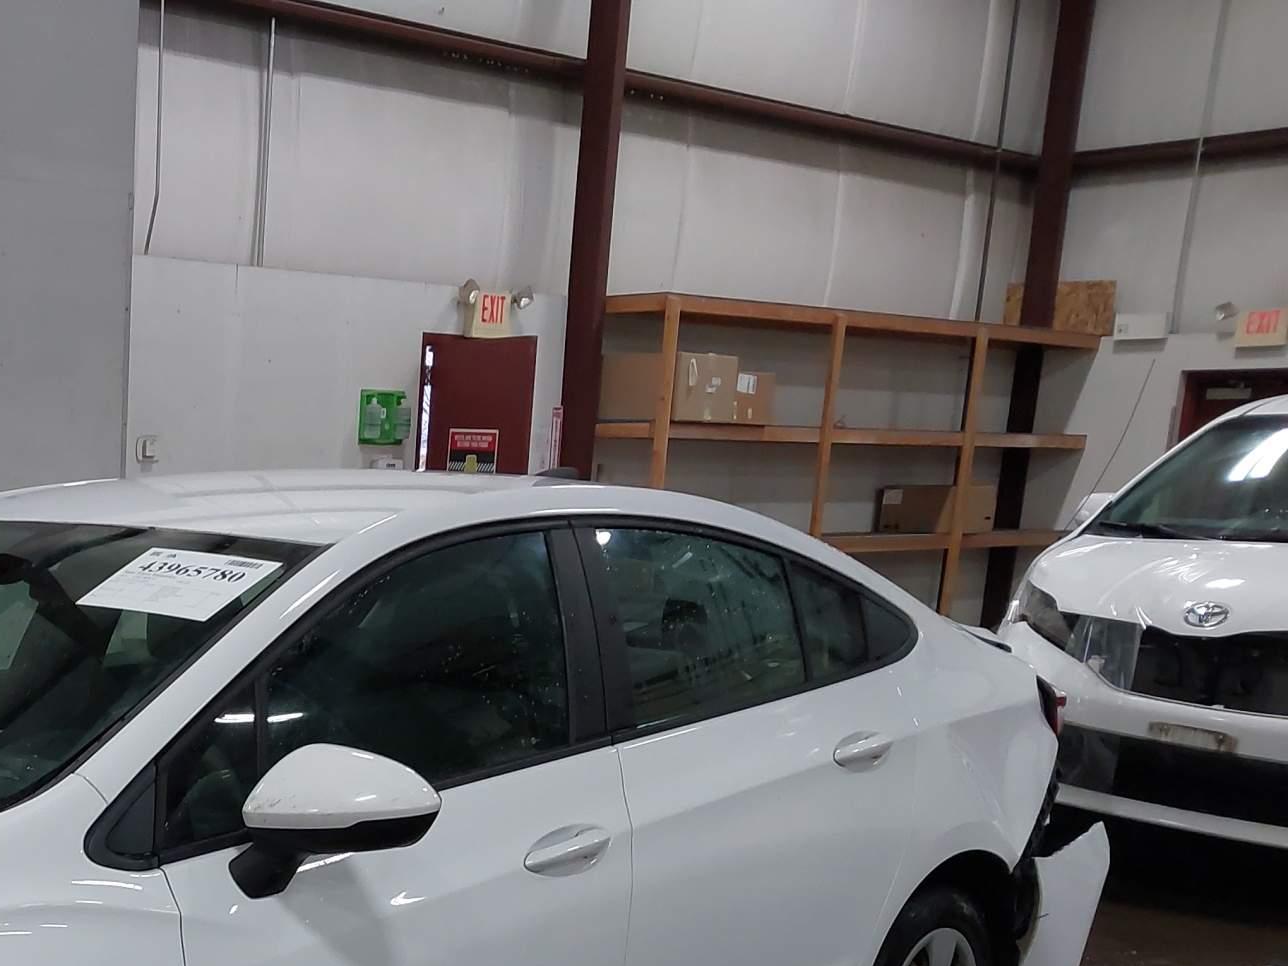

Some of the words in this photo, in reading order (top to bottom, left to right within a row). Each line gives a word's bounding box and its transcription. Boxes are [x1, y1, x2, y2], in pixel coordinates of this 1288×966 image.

[481, 294, 506, 324] EXIT
[1245, 310, 1281, 335] EXIT
[138, 560, 246, 583] 43965780
